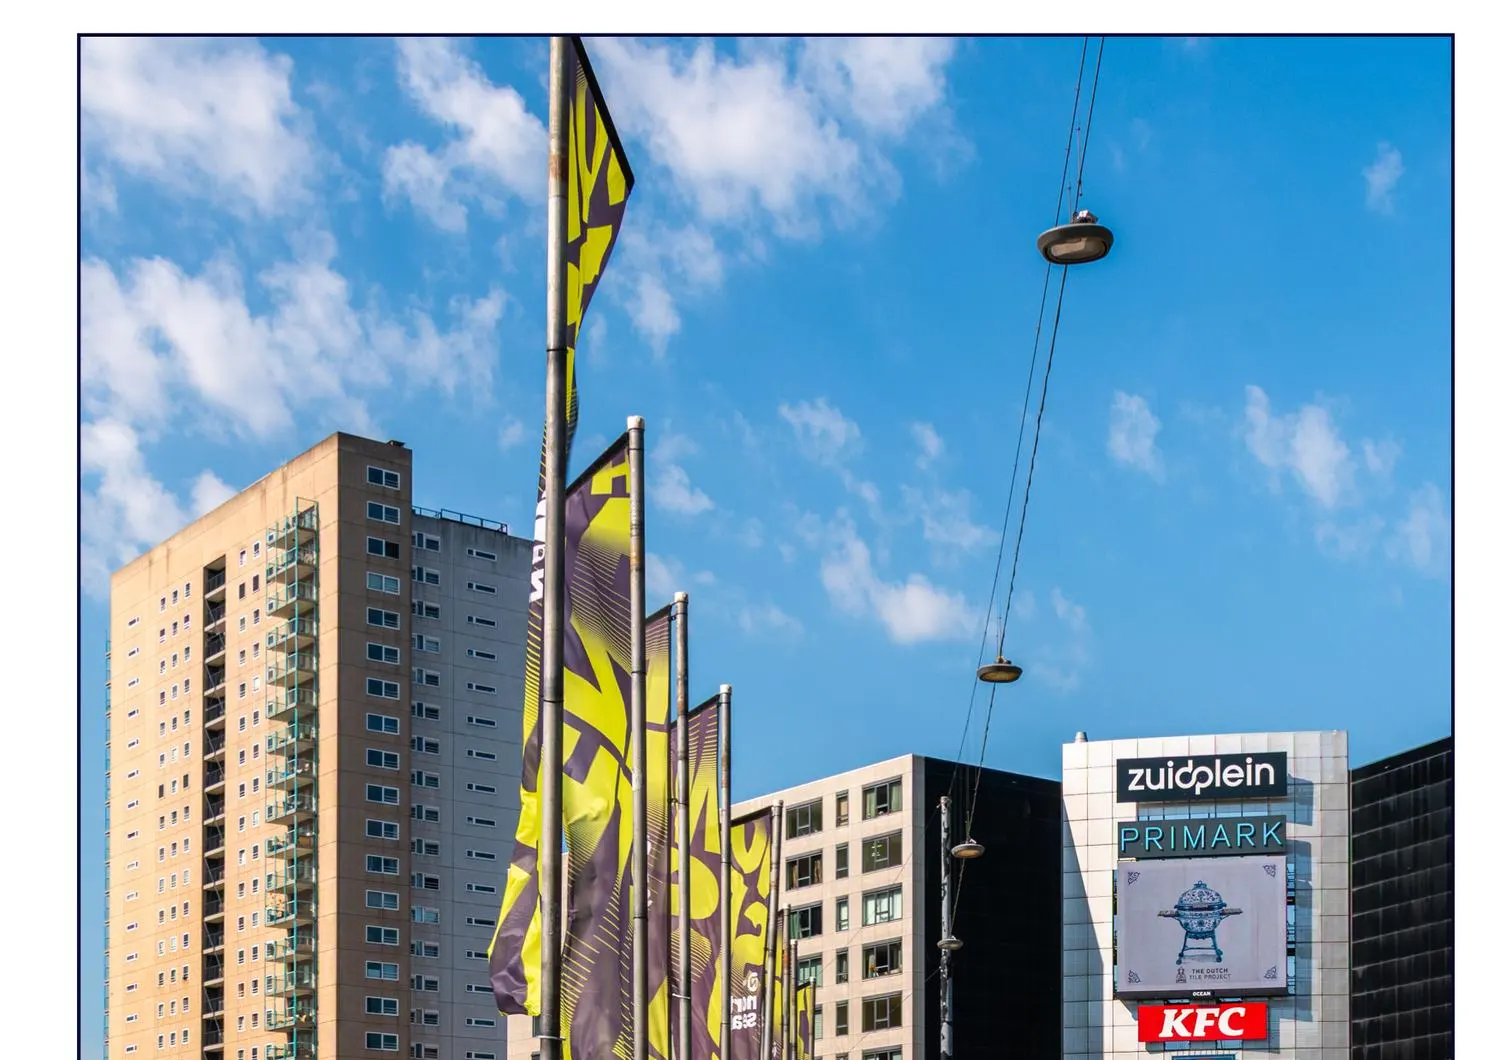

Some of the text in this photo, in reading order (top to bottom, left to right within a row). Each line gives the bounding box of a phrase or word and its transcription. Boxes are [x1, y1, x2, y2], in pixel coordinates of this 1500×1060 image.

[1128, 757, 1274, 795] zuidplein
[1120, 821, 1283, 852] PRIMARK
[1158, 1006, 1246, 1038] KFC
